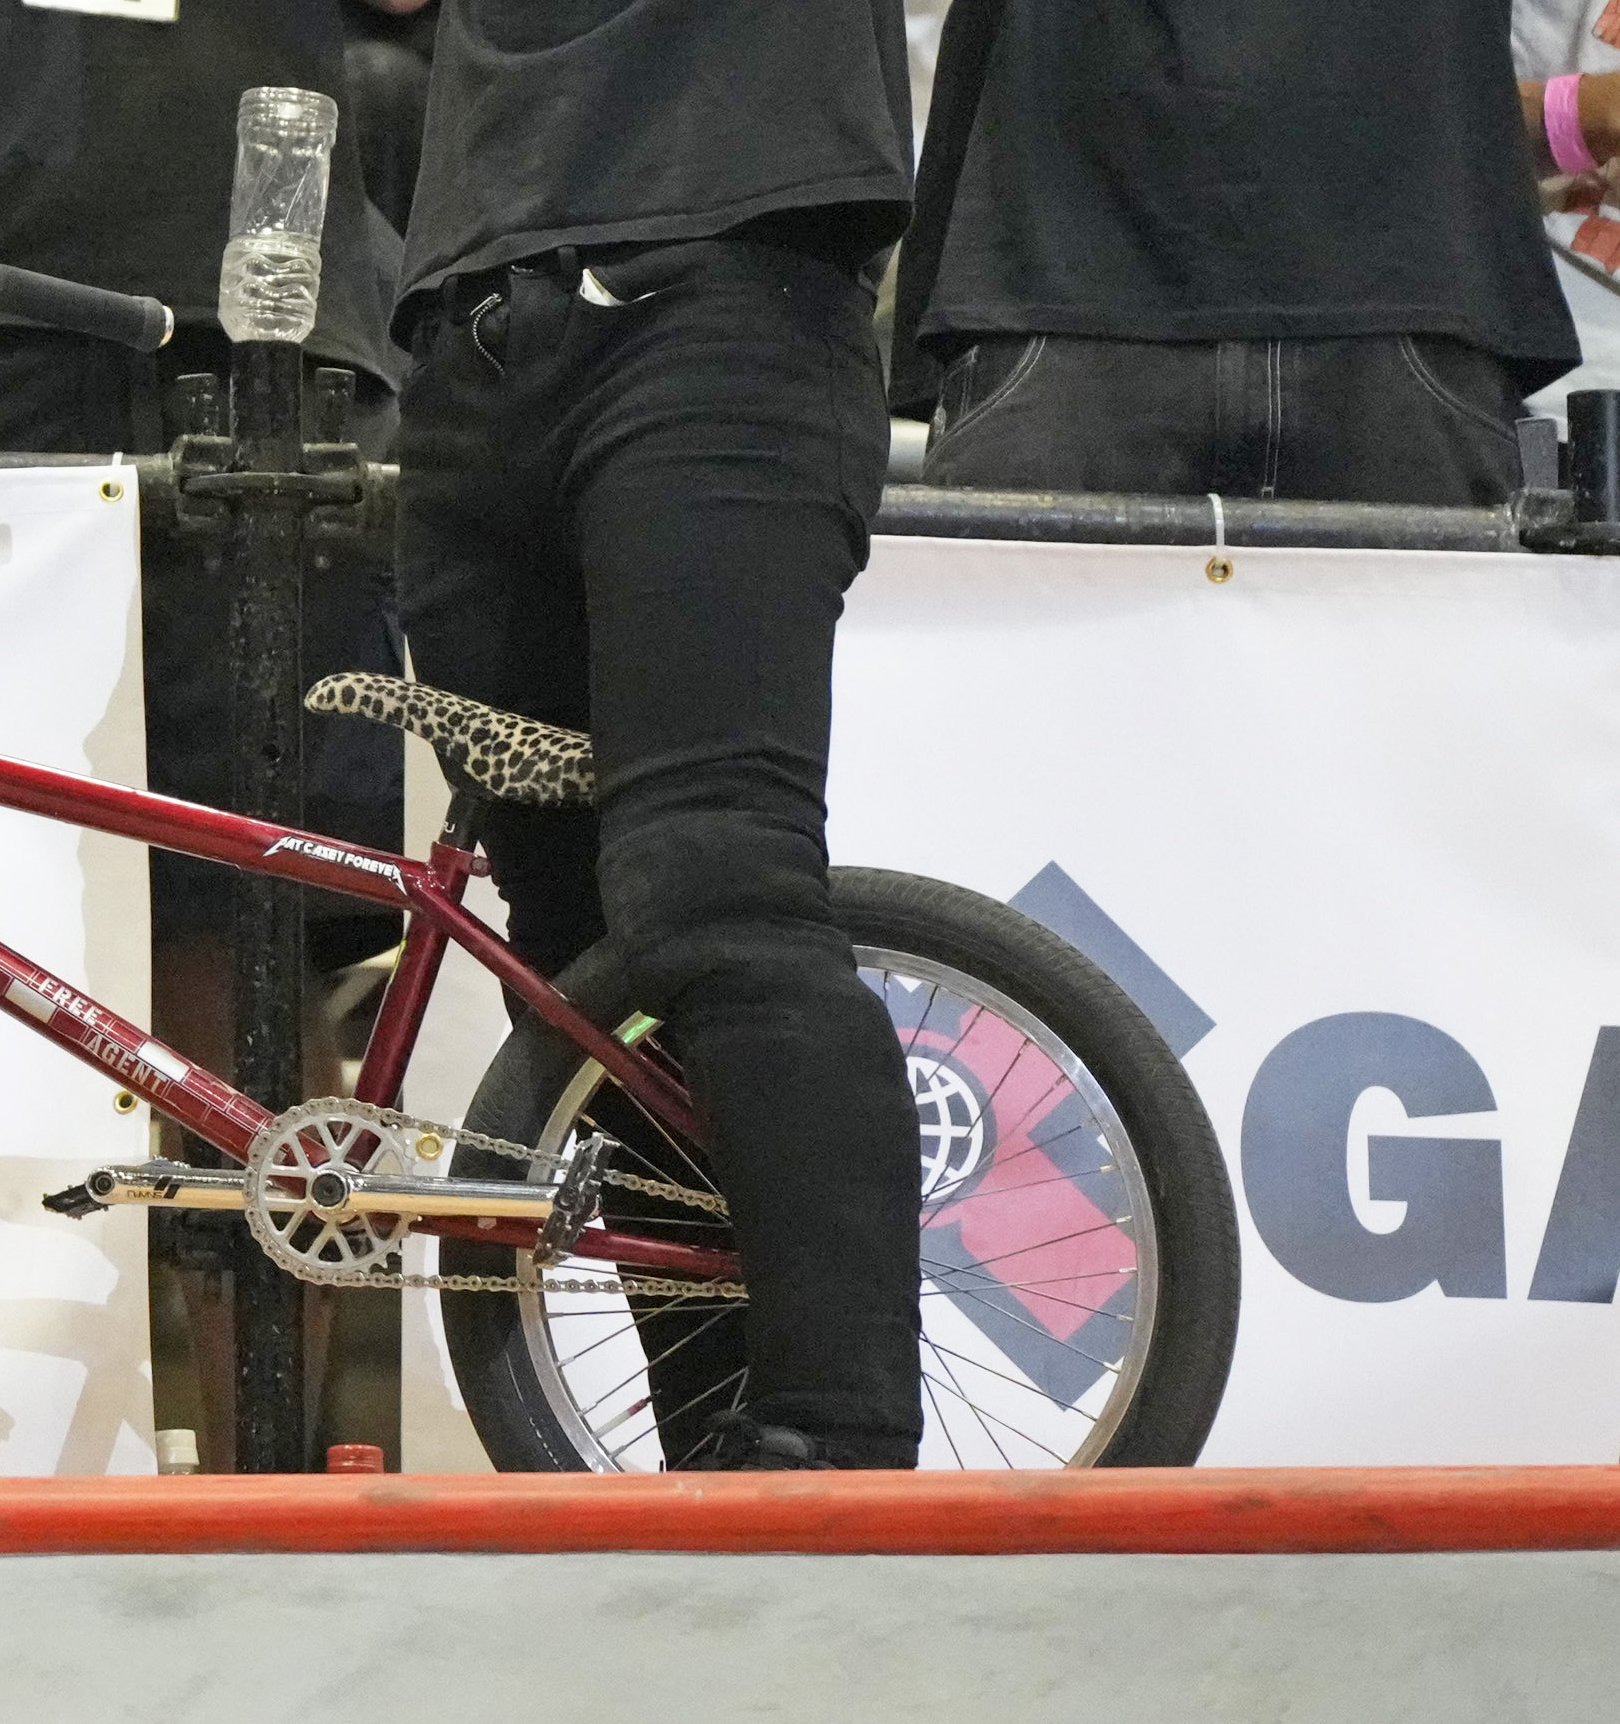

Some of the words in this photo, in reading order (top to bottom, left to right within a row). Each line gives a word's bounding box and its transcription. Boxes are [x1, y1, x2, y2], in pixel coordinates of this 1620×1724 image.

[302, 842, 345, 864] CASEY
[38, 976, 104, 1027] FREE
[86, 1033, 169, 1095] AGENT
